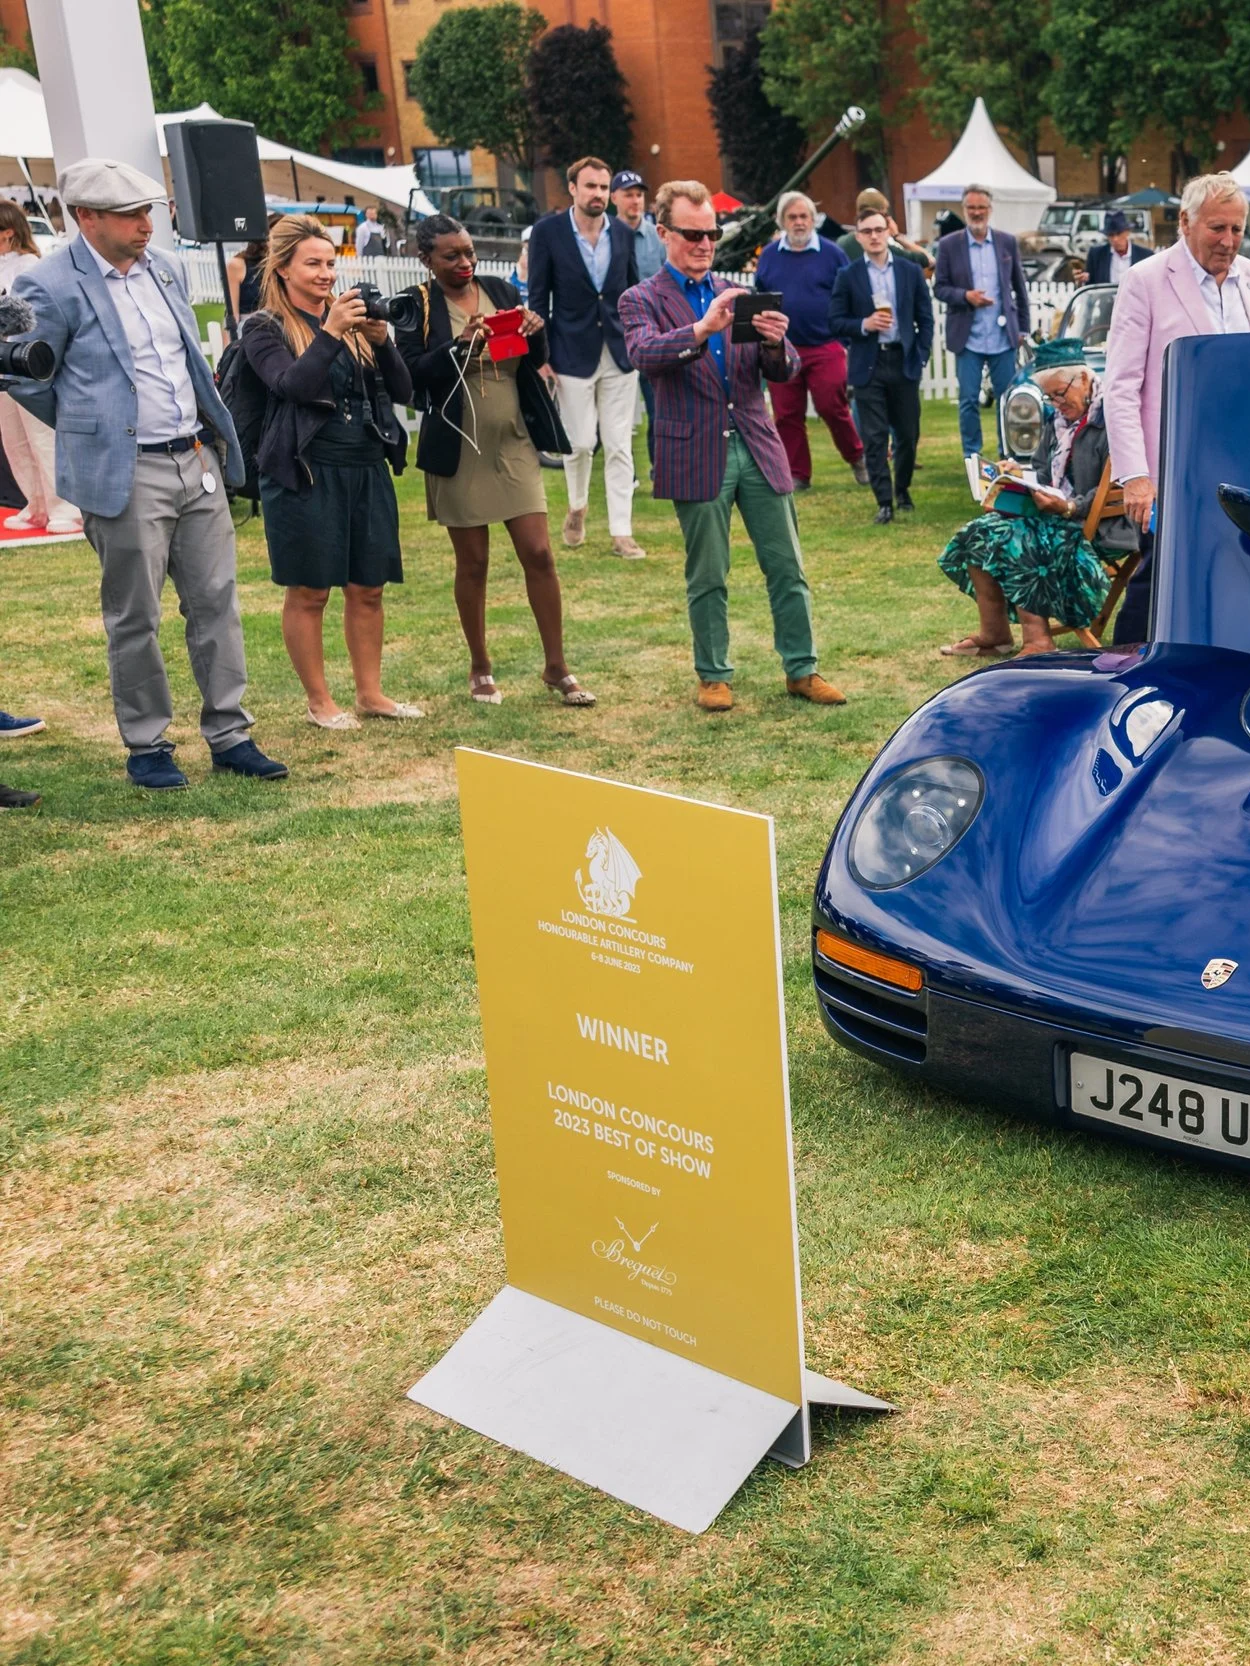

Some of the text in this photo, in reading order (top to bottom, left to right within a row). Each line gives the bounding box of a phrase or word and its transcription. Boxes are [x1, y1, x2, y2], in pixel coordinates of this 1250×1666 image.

[538, 920, 694, 974] HONOURABLE ARTILLERY COMPANY
[561, 910, 667, 949] LONDON CONCOURS
[591, 952, 641, 974] 6-8 JUNE 2023
[576, 1013, 669, 1065] WINNER
[547, 1081, 714, 1155] LONDON CONCOURS
[1090, 1069, 1205, 1135] J248
[554, 1109, 711, 1179] 2023 BEST OF SHOW
[607, 1170, 661, 1197] SPONSORED BY
[591, 1239, 677, 1287] Breguet
[594, 1296, 697, 1346] PLEASE DO NOT TOUCH
